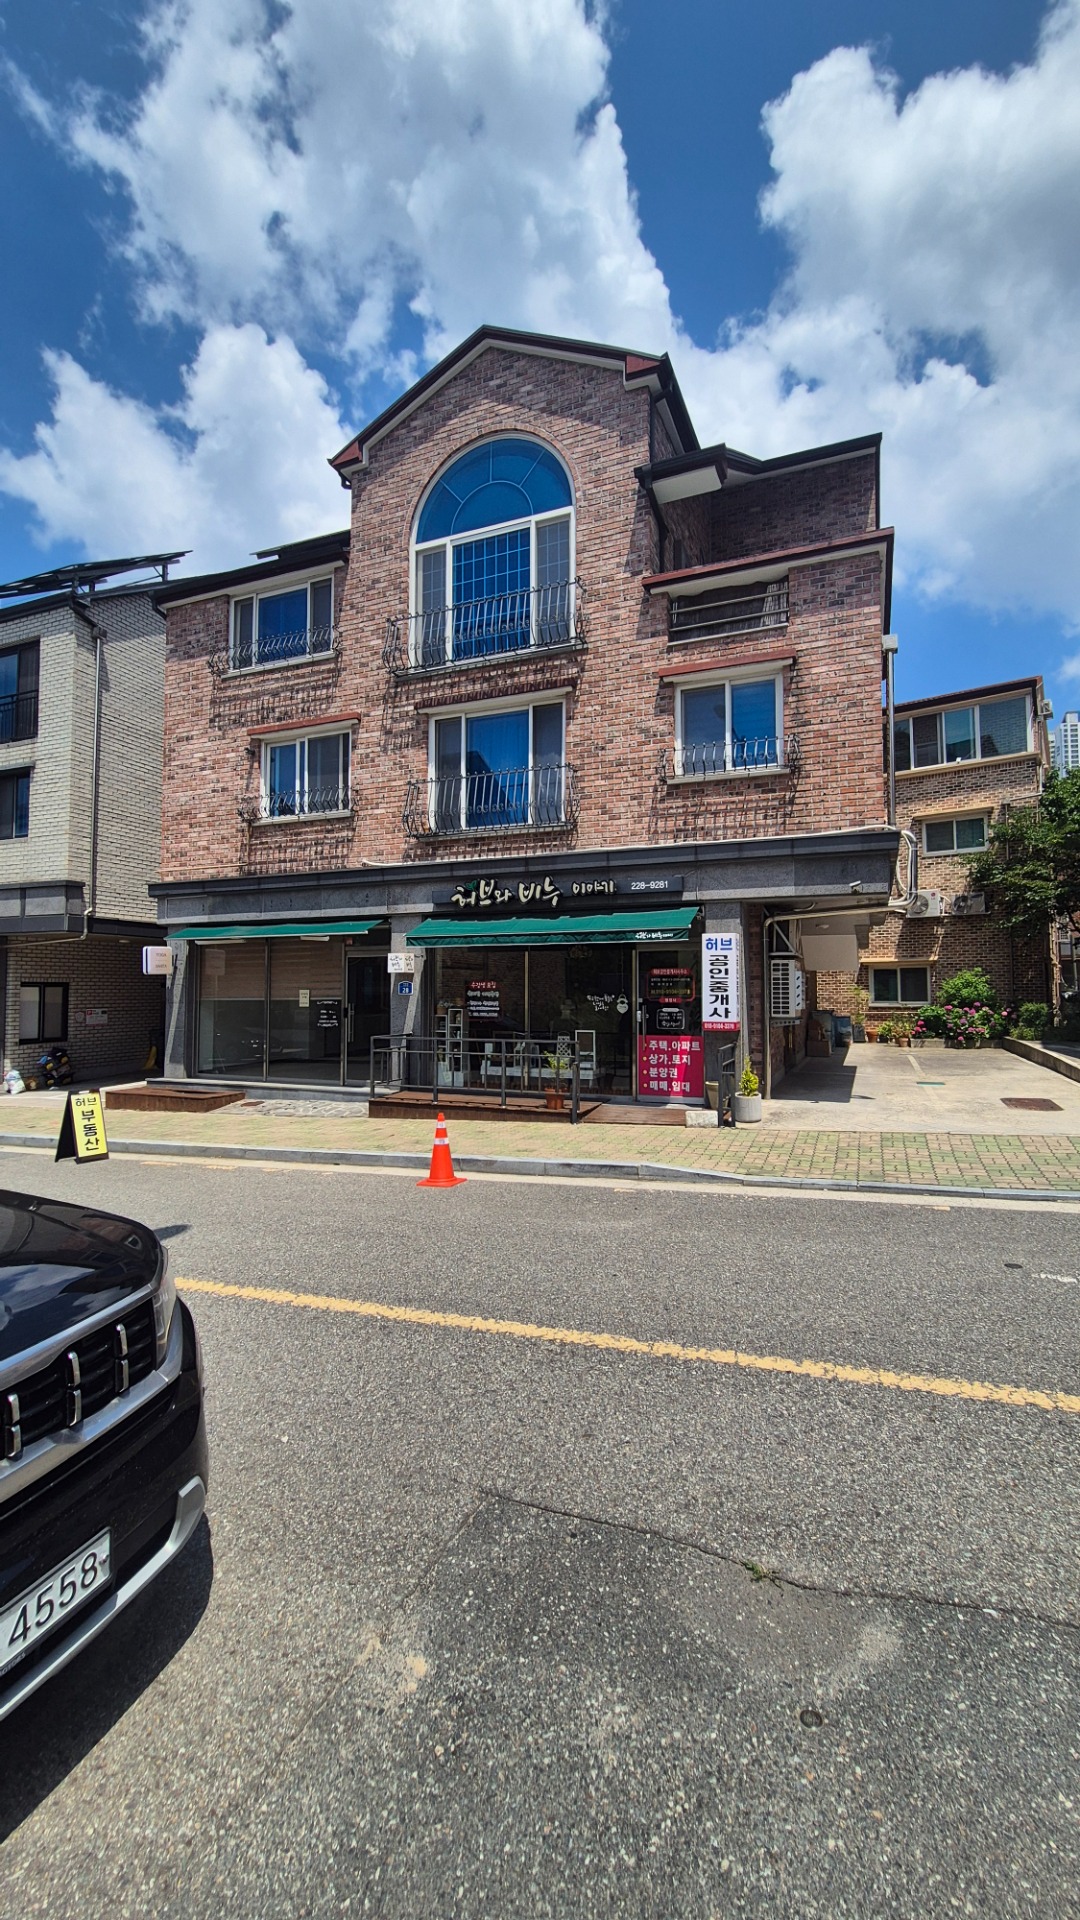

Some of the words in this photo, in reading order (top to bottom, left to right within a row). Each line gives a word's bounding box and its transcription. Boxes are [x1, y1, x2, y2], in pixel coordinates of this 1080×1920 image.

[451, 879, 512, 907] 허브와
[518, 876, 562, 907] 비누
[571, 880, 615, 895] 이야기
[631, 880, 668, 890] 228-9281
[705, 937, 733, 951] 허브
[709, 954, 731, 1019] 공인중개사
[648, 1040, 701, 1051] 주택.아파트
[648, 1053, 691, 1066] 상가.토지
[648, 1067, 678, 1078] 분양권
[649, 1080, 690, 1092] 매매.임대
[75, 1097, 97, 1107] 허브
[82, 1109, 100, 1151] 부동산
[8, 1551, 98, 1646] 4558
[0, 1652, 26, 1676] OTORS
